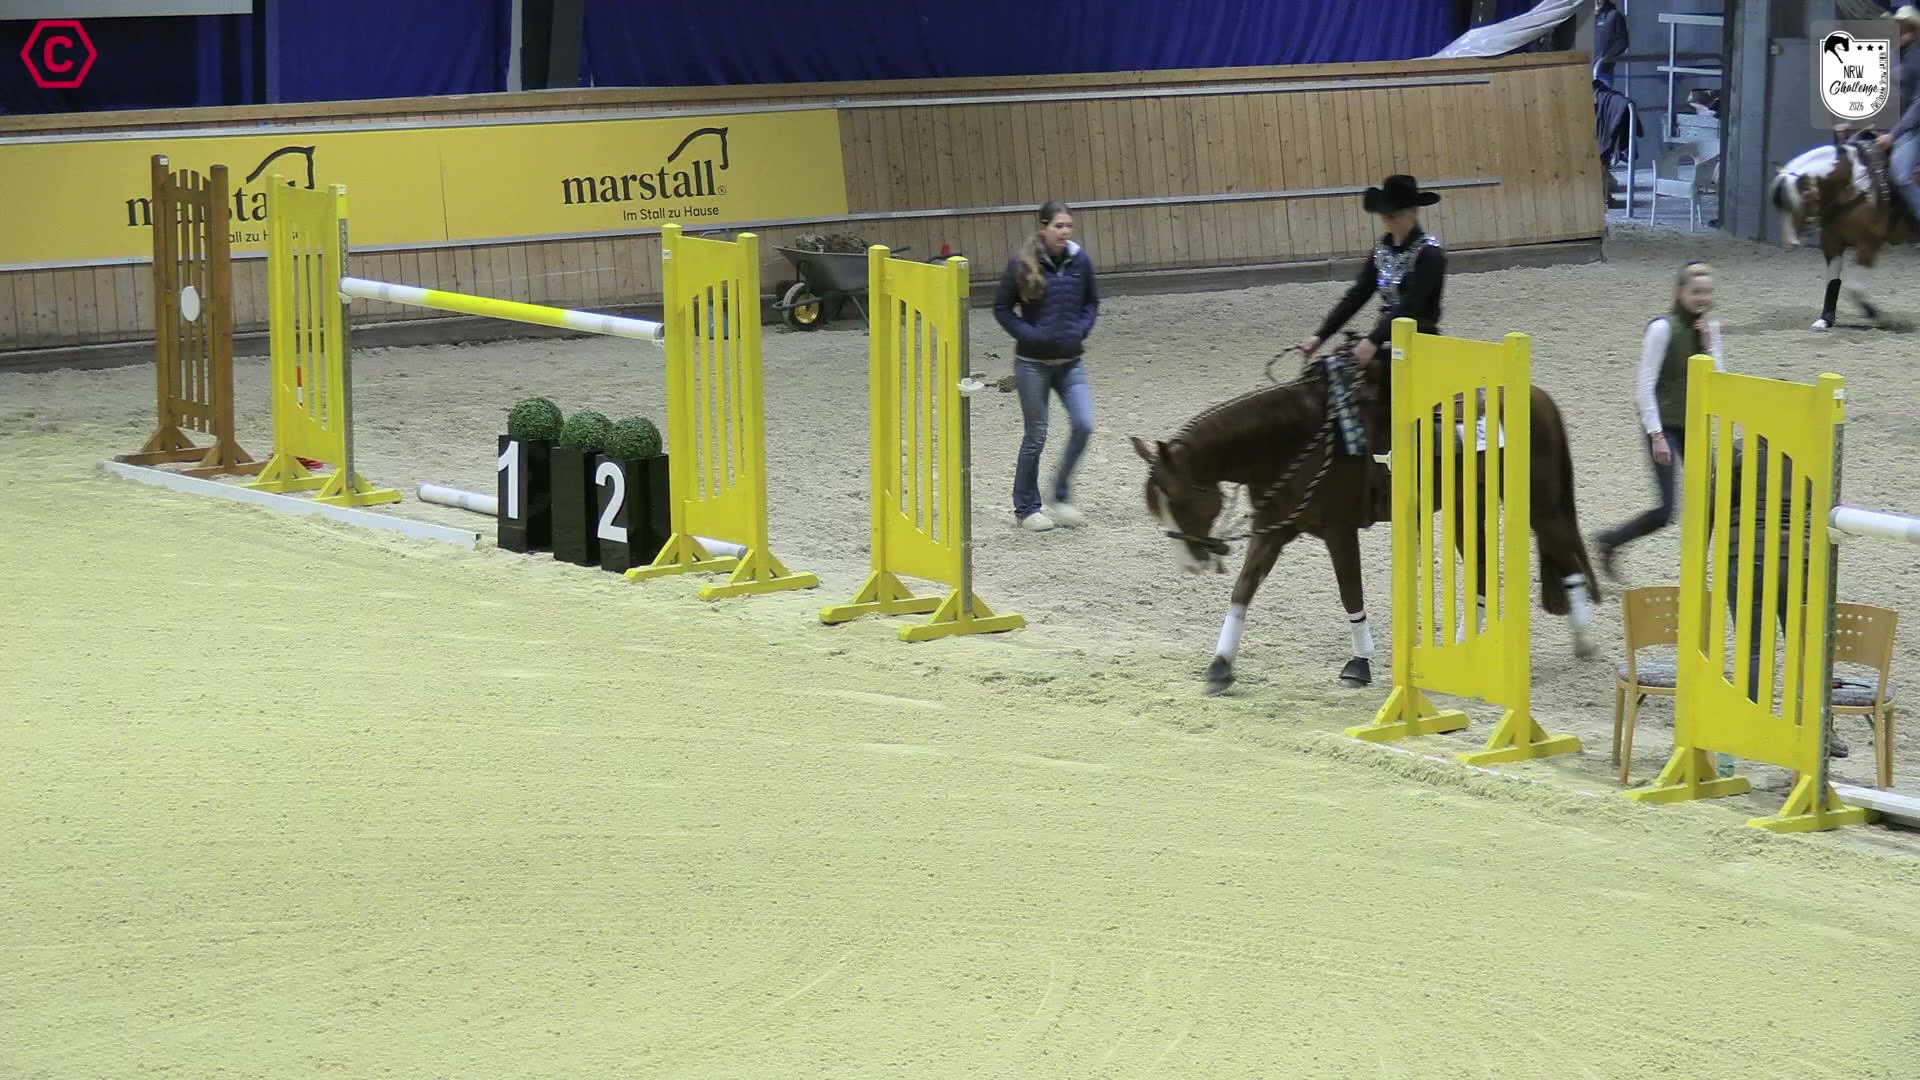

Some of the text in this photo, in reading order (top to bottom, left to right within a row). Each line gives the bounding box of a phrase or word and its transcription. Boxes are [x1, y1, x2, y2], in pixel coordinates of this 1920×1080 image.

[623, 206, 720, 221] Im Stall zu Hause
[246, 233, 260, 243] zu
[498, 440, 519, 520] 1
[595, 461, 628, 544] 2
